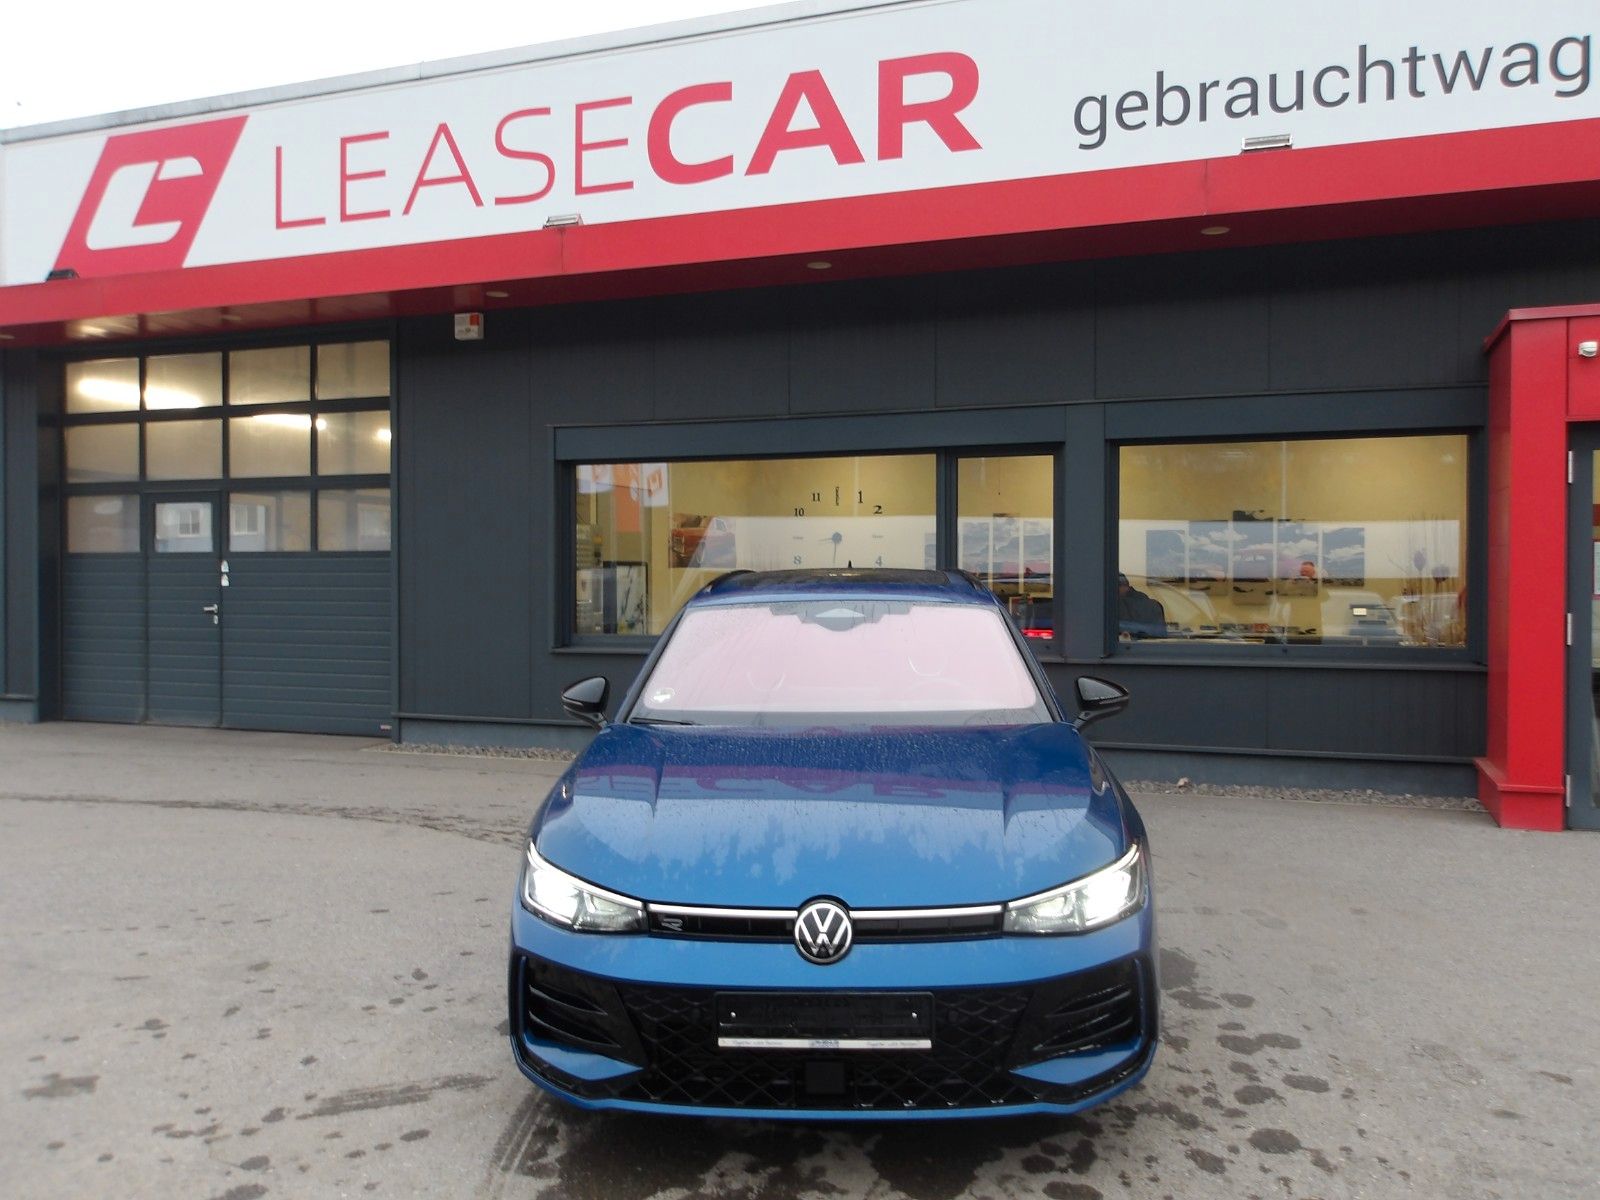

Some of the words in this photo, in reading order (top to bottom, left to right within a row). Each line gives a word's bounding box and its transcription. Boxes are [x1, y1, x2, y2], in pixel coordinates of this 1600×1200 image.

[1073, 34, 1593, 150] gebrauchtwag
[276, 51, 983, 230] LEASECAR
[794, 507, 805, 517] 10
[873, 504, 883, 515] 2
